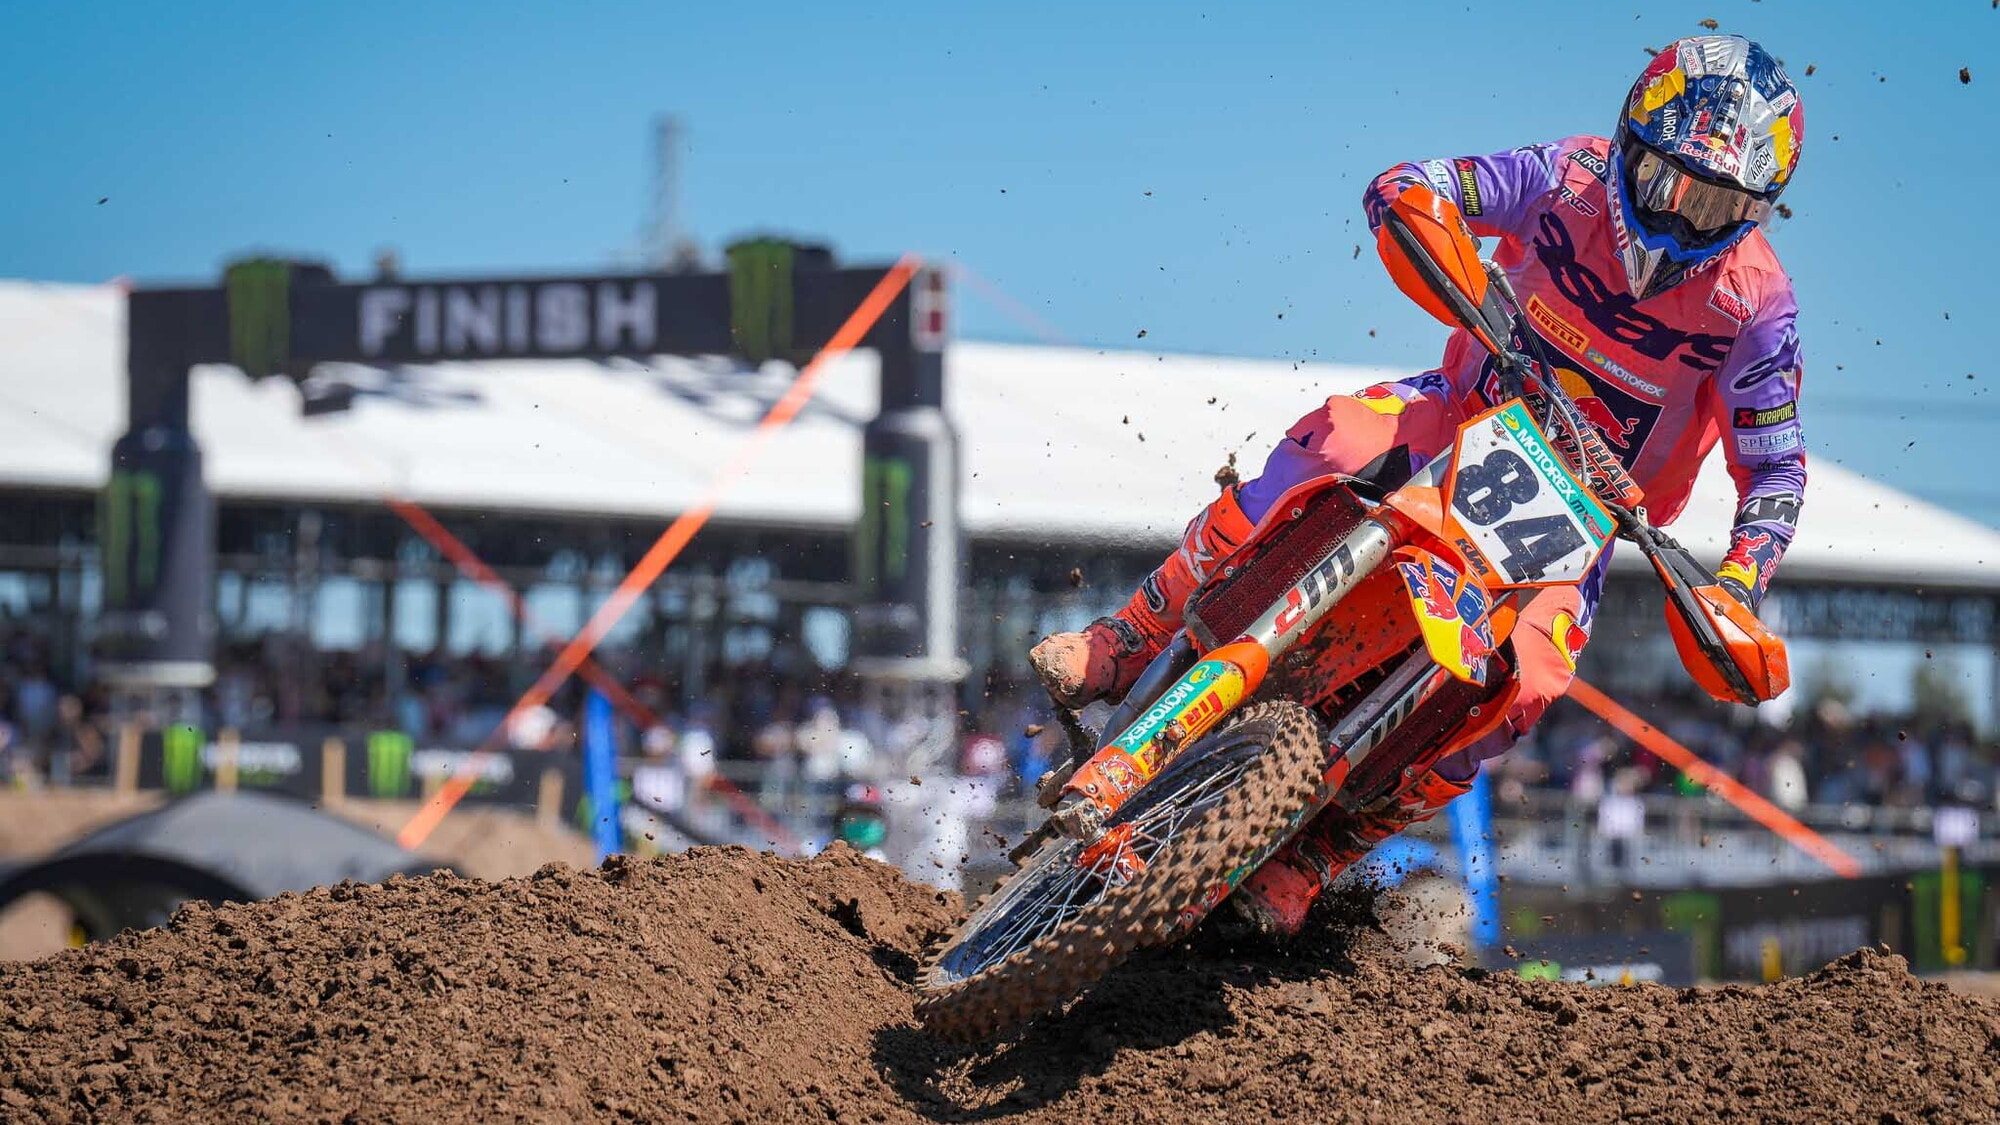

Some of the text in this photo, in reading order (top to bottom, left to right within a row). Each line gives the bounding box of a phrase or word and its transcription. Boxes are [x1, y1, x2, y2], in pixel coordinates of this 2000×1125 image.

[1662, 109, 1677, 141] AIROH
[1680, 143, 1741, 177] Red Bull
[1750, 148, 1773, 181] AIROH
[359, 282, 658, 356] FINISH
[1528, 299, 1586, 349] PIRELLI
[1604, 360, 1663, 397] MOTOREX
[1517, 428, 1578, 500] MOTOREX
[1452, 449, 1587, 584] 84
[1454, 537, 1490, 575] KTM
[1121, 682, 1195, 746] MOTOREX
